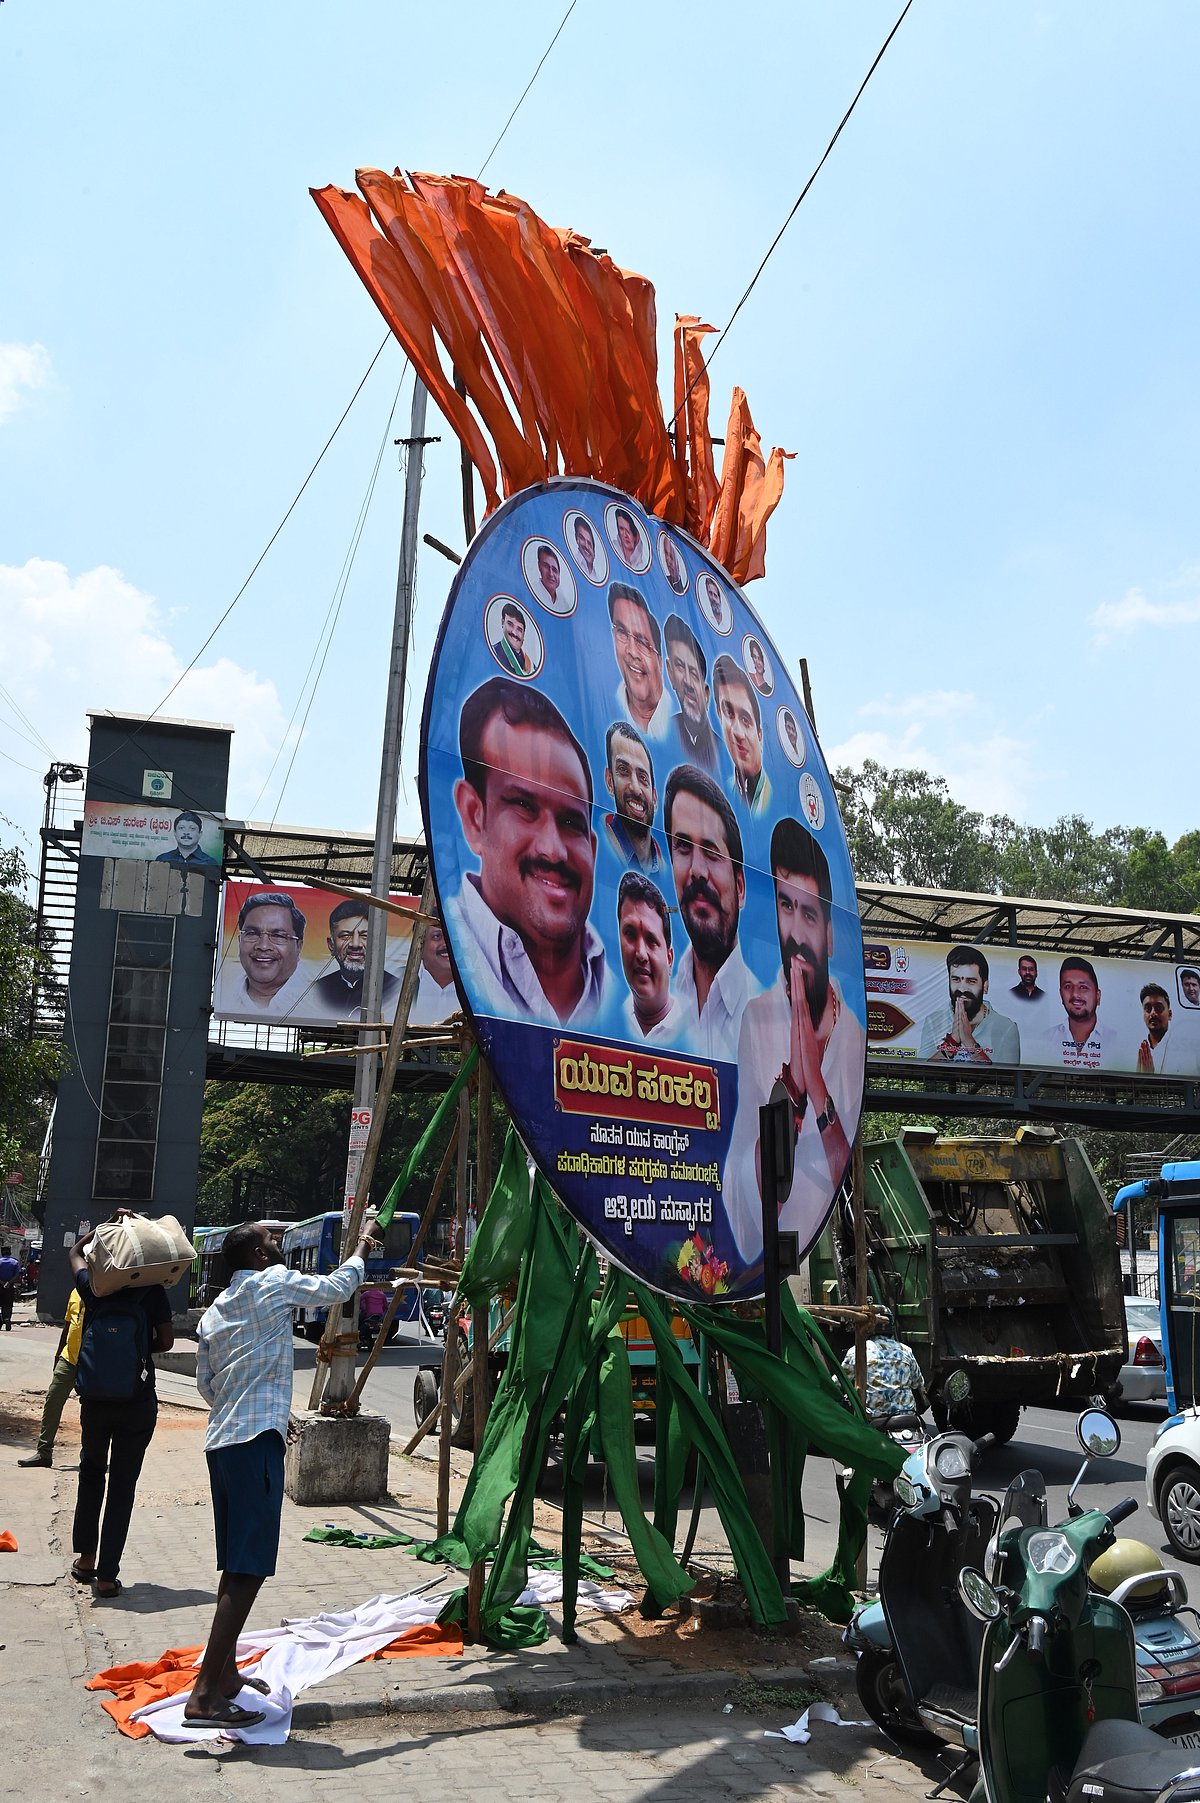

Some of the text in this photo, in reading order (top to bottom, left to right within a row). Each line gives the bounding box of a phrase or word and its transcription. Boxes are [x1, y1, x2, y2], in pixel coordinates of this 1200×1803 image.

[88, 815, 97, 827] ಶ್ರೀ
[123, 817, 147, 828] ಸುರೇಶ್
[559, 1052, 633, 1097] ಯುವ
[590, 1123, 689, 1157] ನೂತನ ಯುವ ಕಾಂಗ್ರೆಸ್
[557, 1151, 722, 1191] ಪದಾಧಿಕಾರಿಗಳ ಪದಗ್ರಹಣ ಸಮಾರಂಭಕ್ಕೆ
[604, 1193, 713, 1235] ಆತ್ಮೀಯ ಸುಸ್ವಾಗತ
